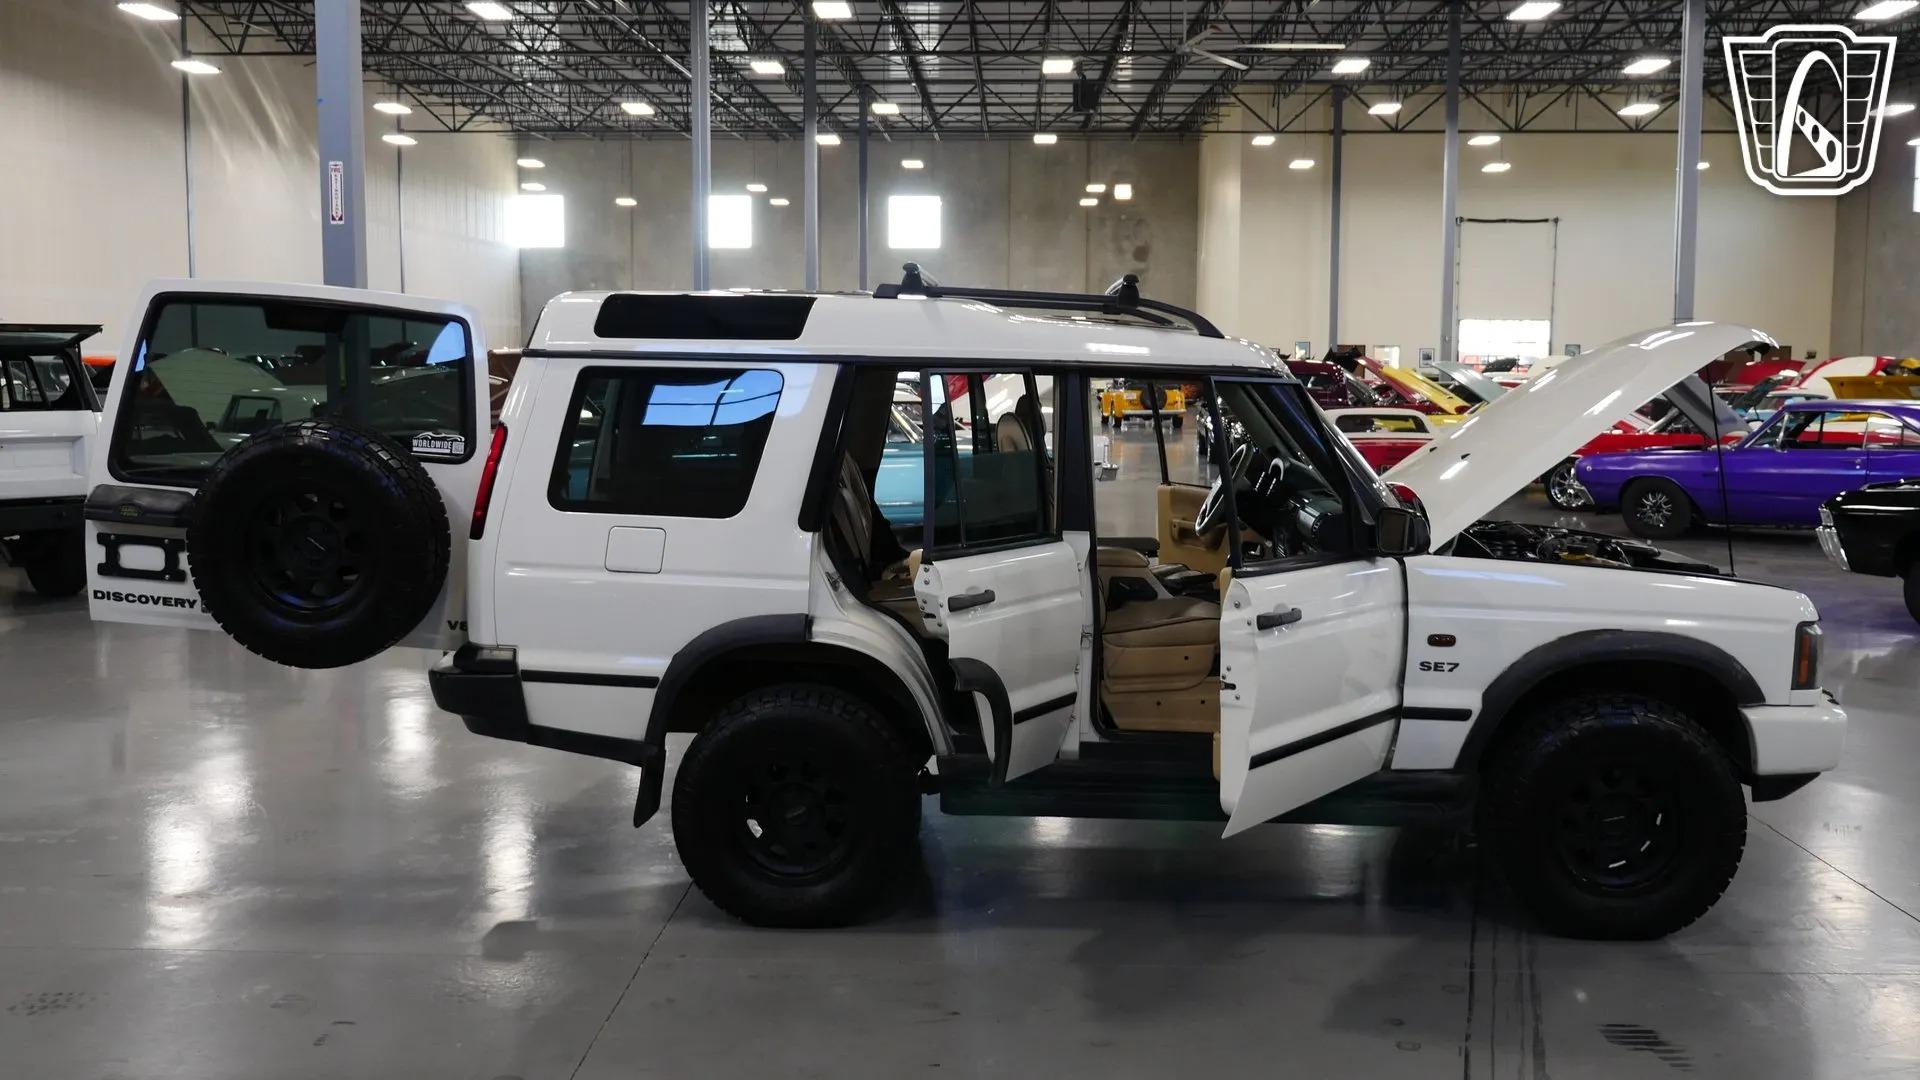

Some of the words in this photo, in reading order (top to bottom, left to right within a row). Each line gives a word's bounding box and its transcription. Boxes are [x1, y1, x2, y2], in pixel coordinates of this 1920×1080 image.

[413, 439, 452, 449] WORLDWIDE
[93, 590, 198, 609] DISCOVERY
[1419, 661, 1460, 673] SE7
